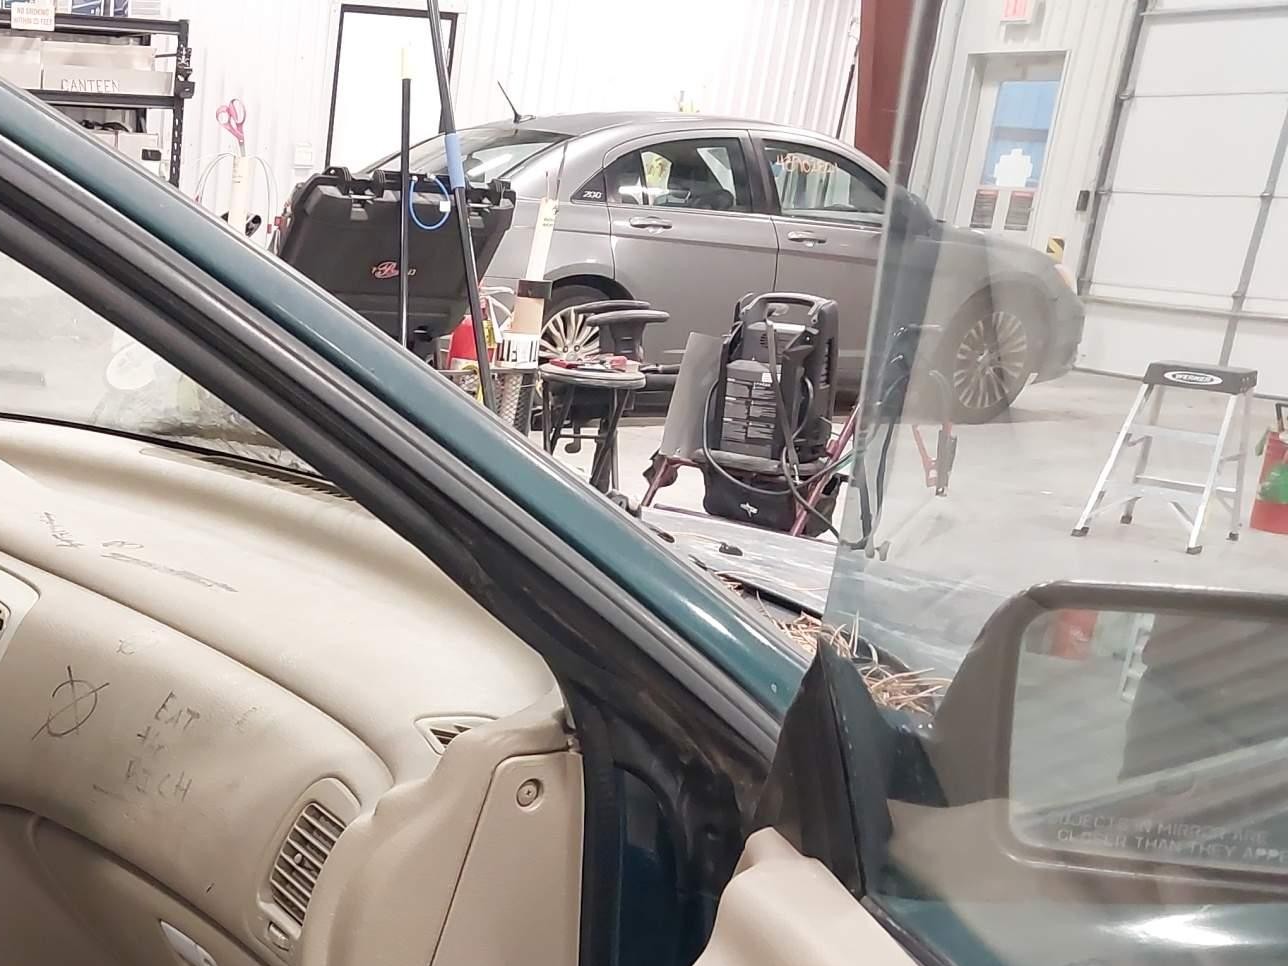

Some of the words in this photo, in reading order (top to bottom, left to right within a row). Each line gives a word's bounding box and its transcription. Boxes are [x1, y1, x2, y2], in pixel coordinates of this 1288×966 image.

[60, 79, 121, 93] CANTEEN
[583, 191, 602, 199] 200
[154, 688, 201, 732] EAT
[123, 758, 193, 803] RICH
[1157, 823, 1224, 841] MIRR
[1135, 836, 1179, 851] THAN
